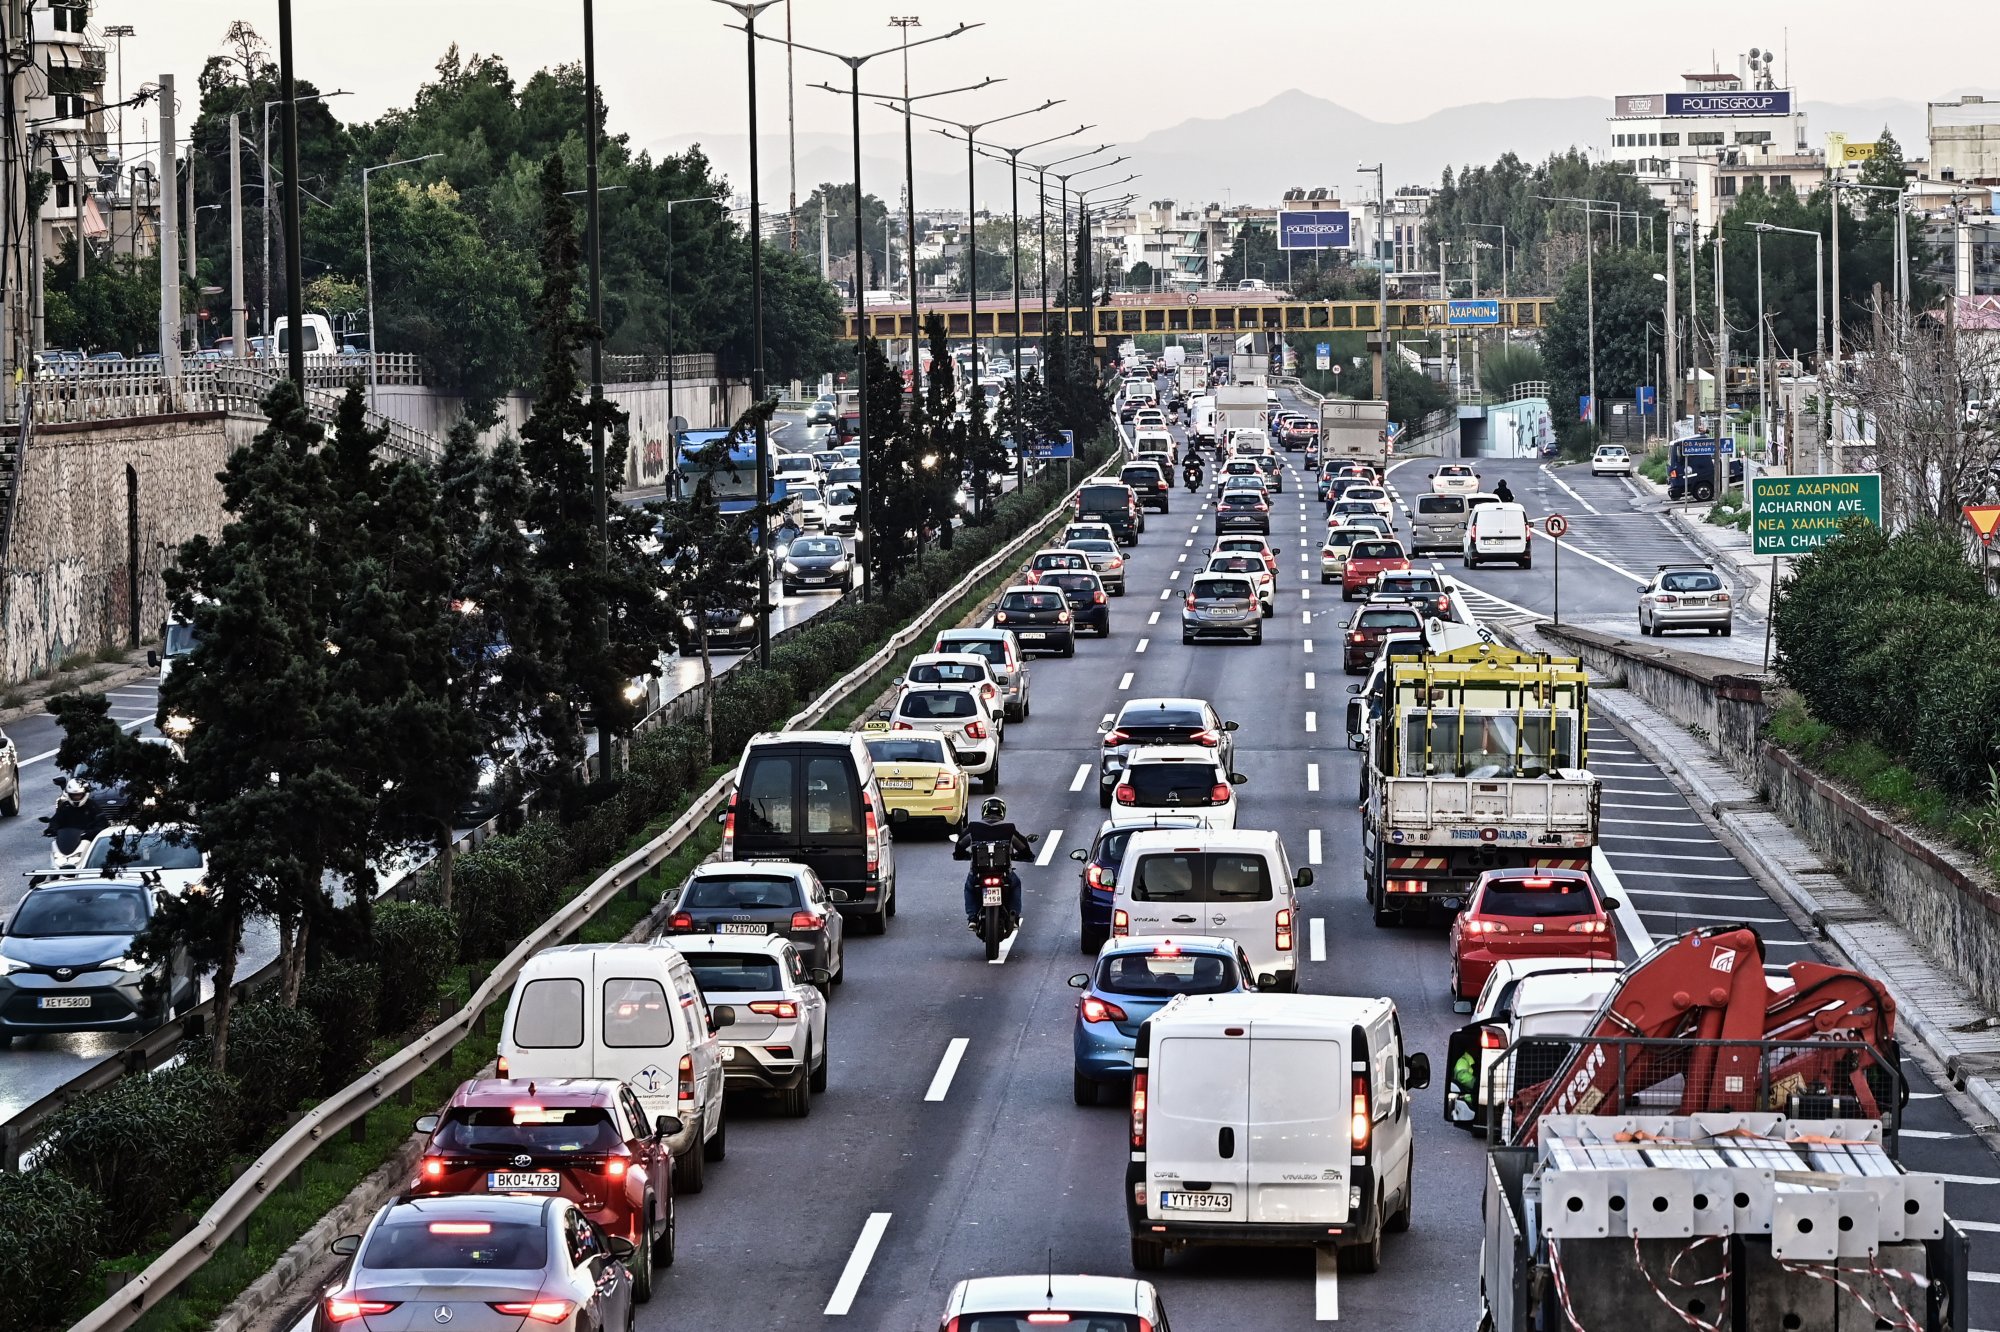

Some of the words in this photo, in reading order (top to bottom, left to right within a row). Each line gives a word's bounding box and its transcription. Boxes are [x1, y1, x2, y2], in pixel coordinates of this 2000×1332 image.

[1758, 484, 1791, 496] ΟΔΟΣ
[1797, 482, 1859, 495] ΑΧΑΡΝΩΝ
[1758, 501, 1832, 514] ACHARNON
[1837, 499, 1866, 511] AVE.
[1758, 519, 1786, 531] ΝΕΑ
[1758, 536, 1786, 548] NEA
